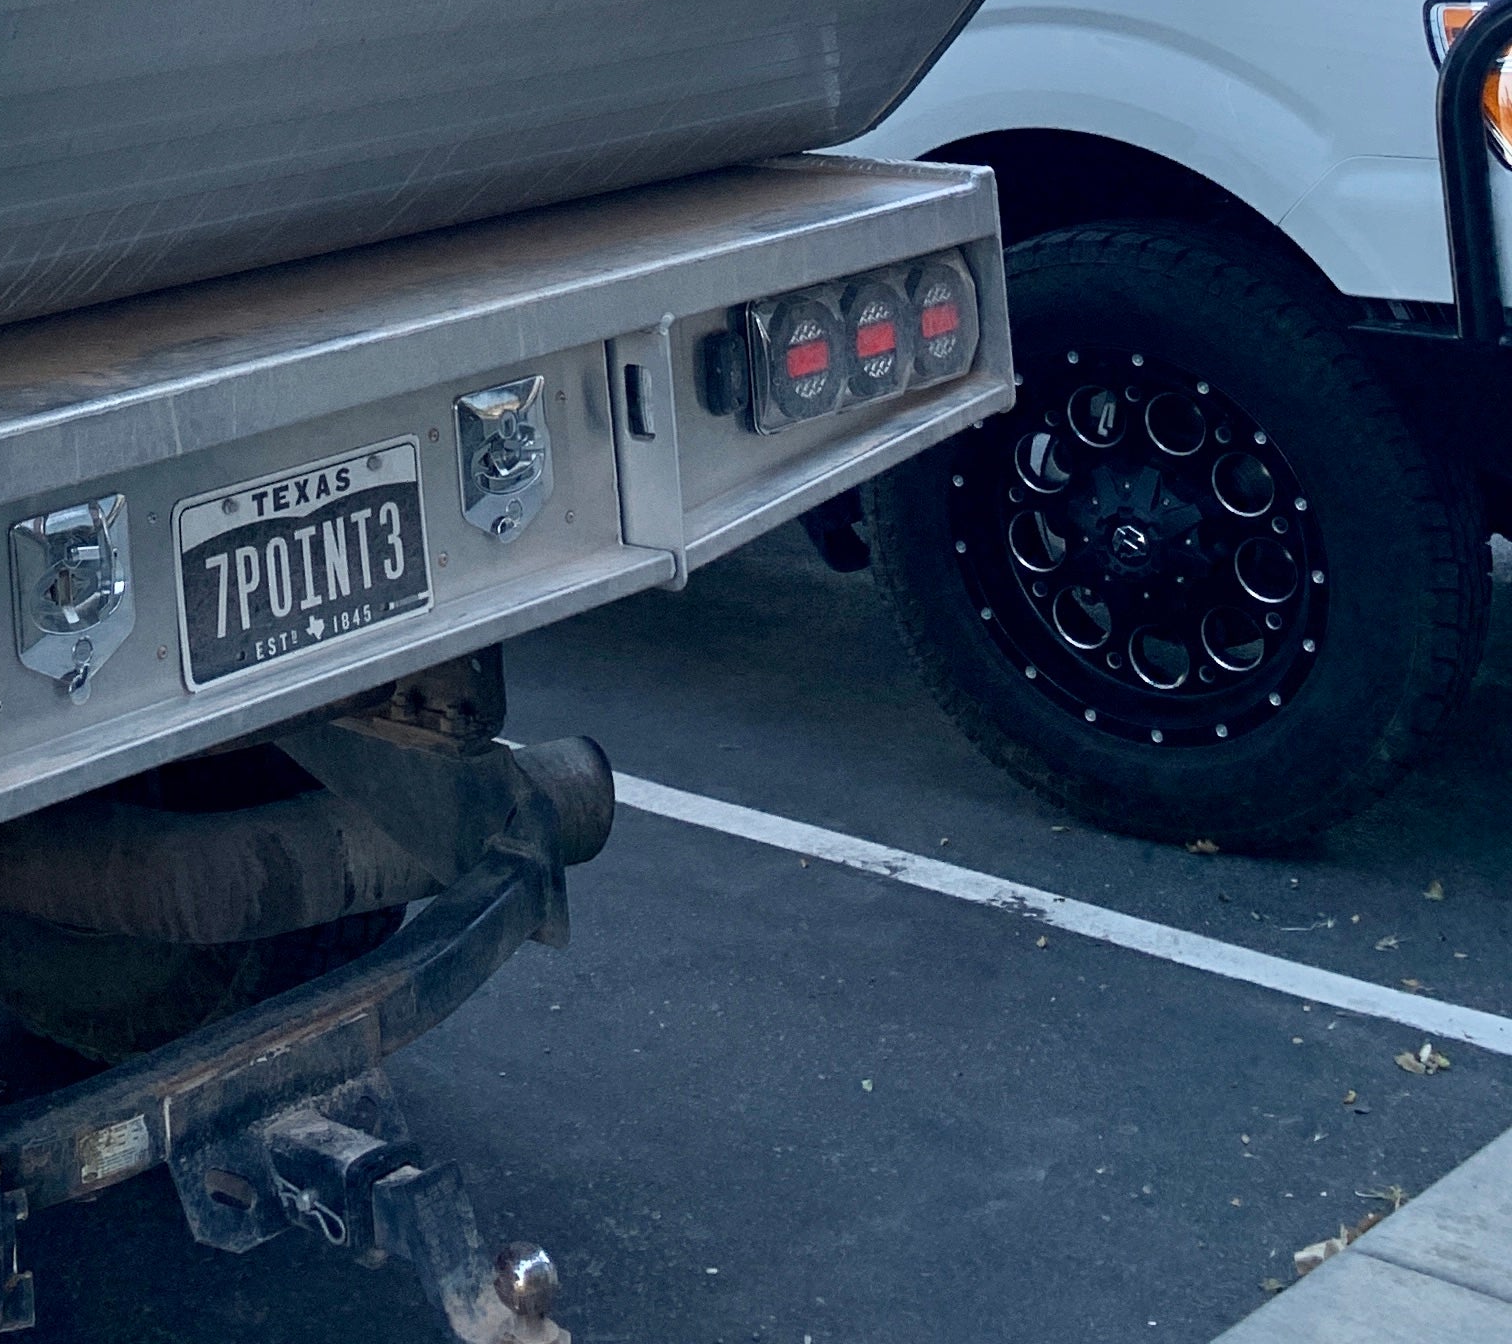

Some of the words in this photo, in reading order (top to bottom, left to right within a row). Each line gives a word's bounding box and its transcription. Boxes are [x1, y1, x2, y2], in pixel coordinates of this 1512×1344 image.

[251, 468, 351, 517] TEXAS
[205, 501, 405, 640] 7POINT3
[333, 604, 372, 633] 1845
